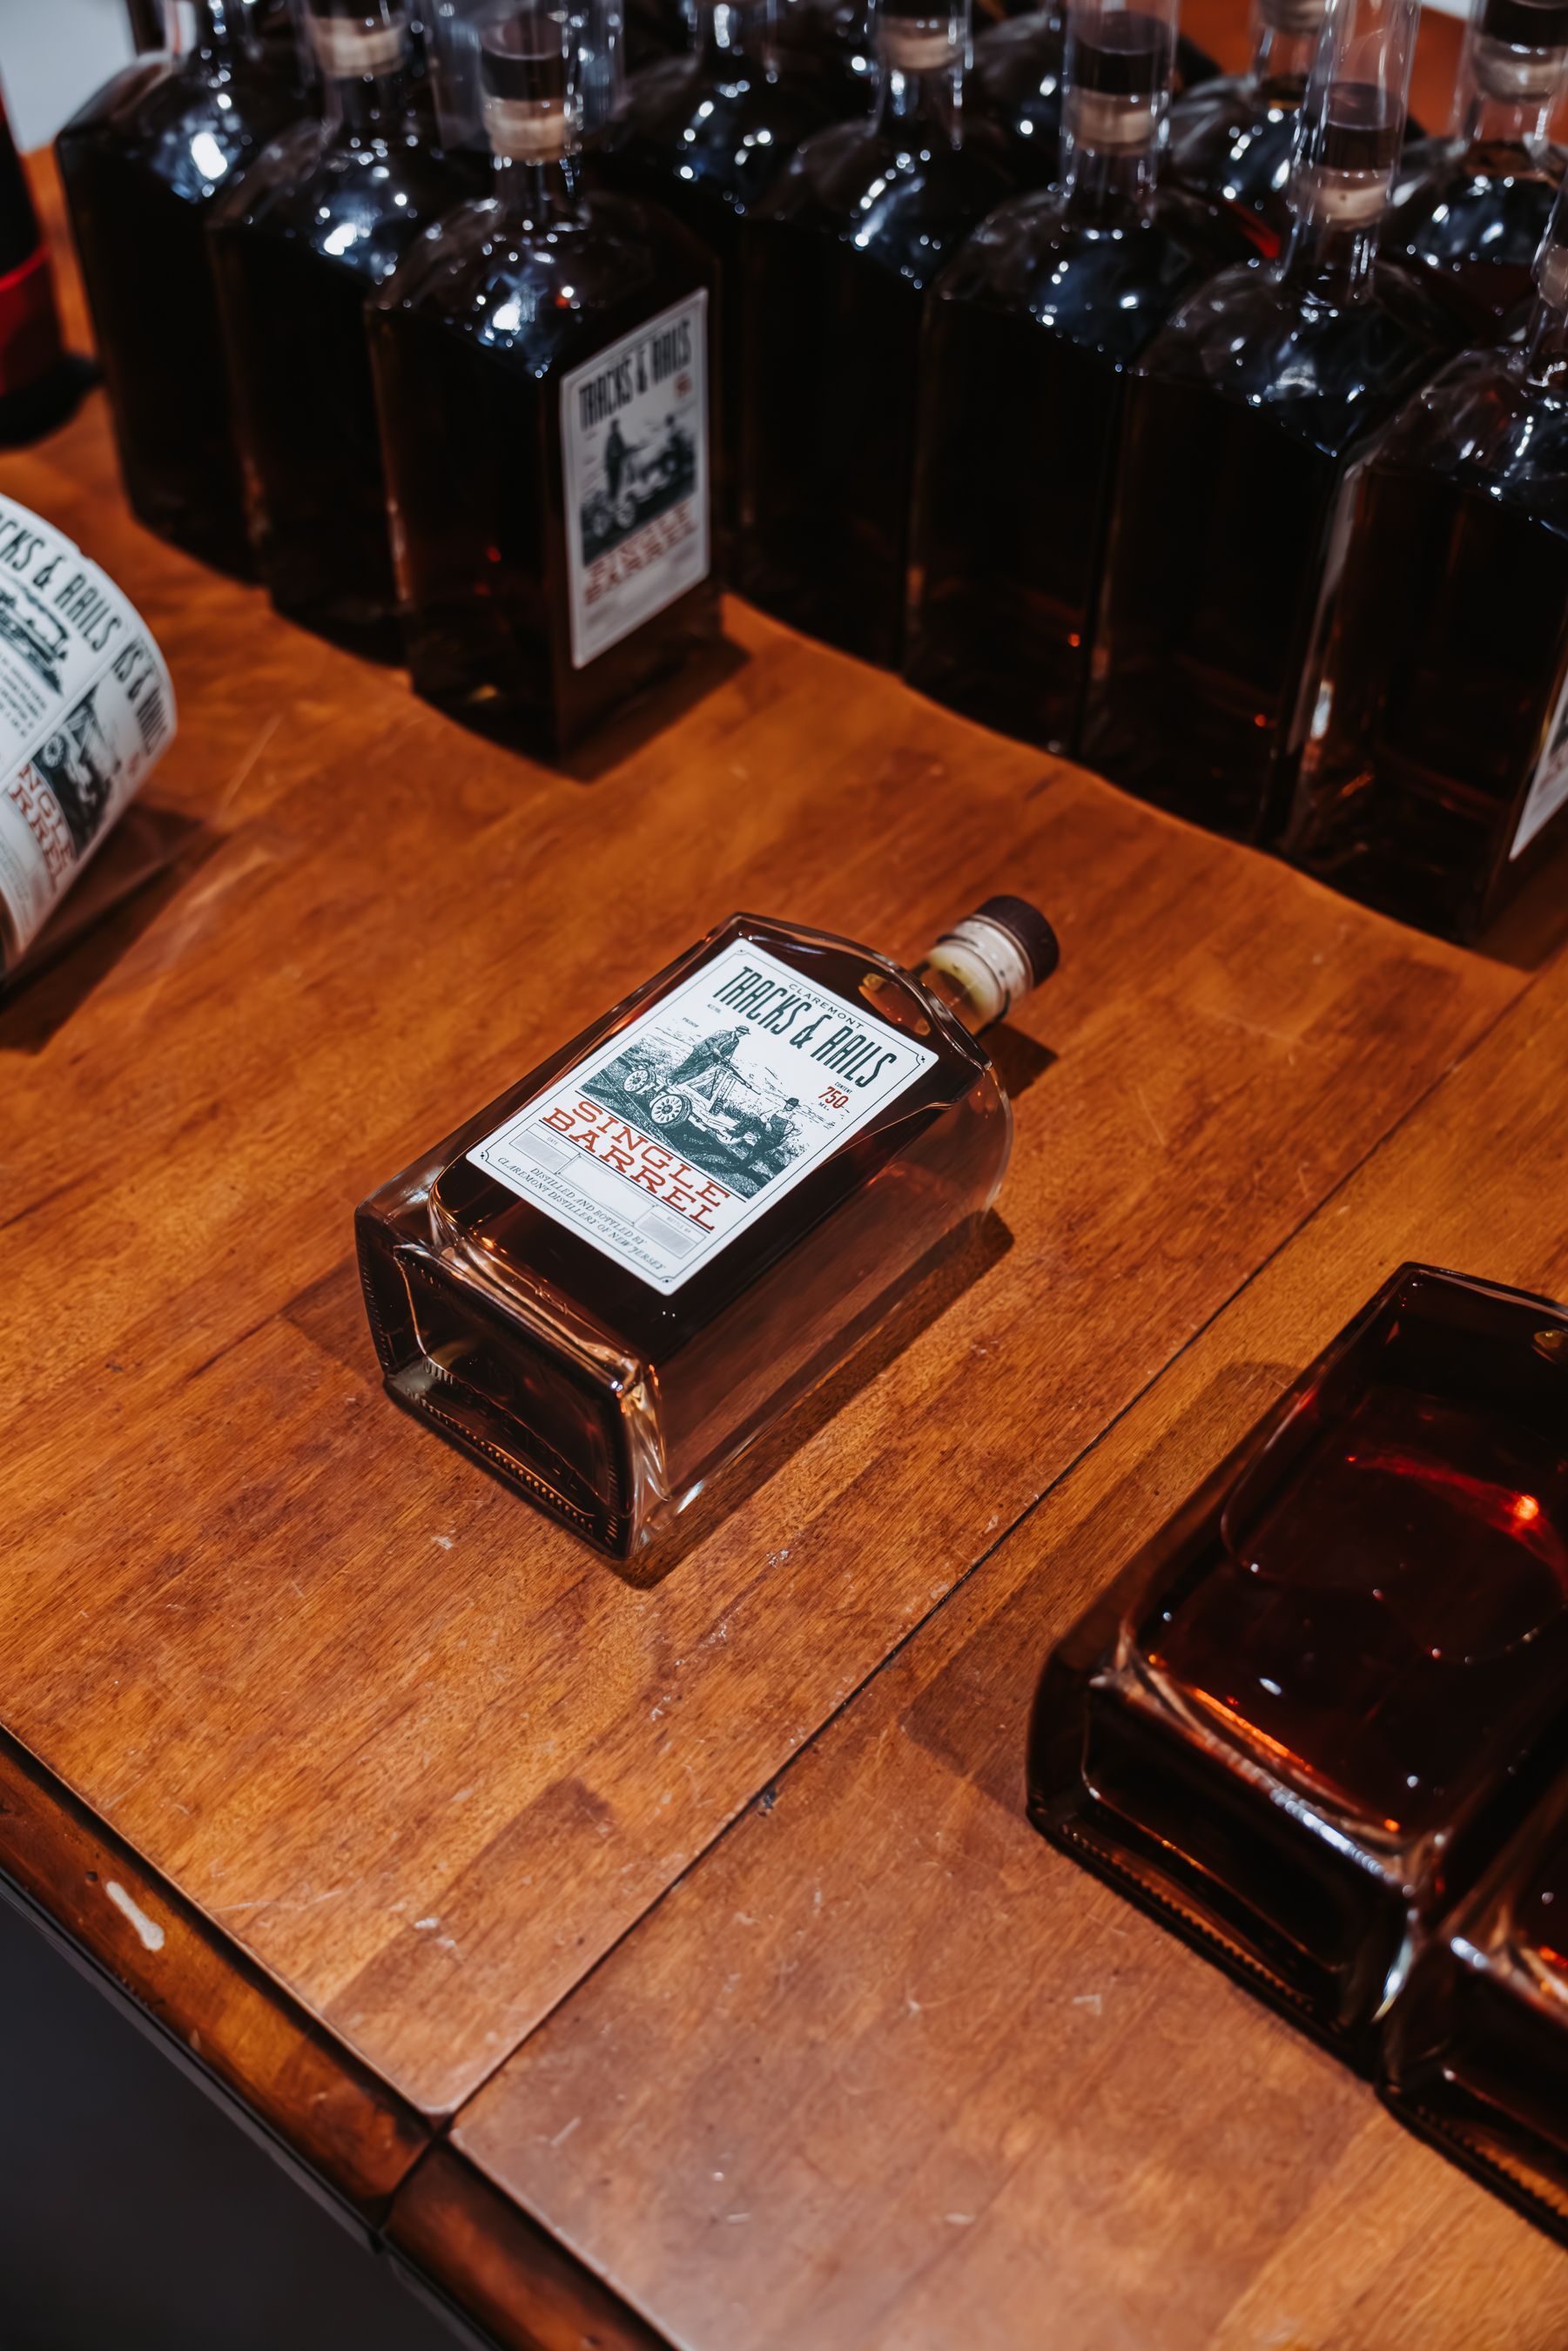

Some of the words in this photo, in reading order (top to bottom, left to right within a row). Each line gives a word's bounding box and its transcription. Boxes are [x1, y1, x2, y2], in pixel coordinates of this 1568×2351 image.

[578, 354, 635, 432] TRACKS
[652, 319, 692, 385] RAILS
[33, 553, 65, 590] &
[54, 574, 122, 651] RAILS
[712, 966, 812, 1035] TRACKS
[788, 983, 865, 1029] CLAREMONT
[789, 1014, 833, 1049] &
[810, 1026, 898, 1088] RAILS
[818, 1086, 849, 1109] 750
[542, 1107, 715, 1231] BARREL
[572, 1101, 730, 1208] SINGLE
[497, 1157, 551, 1197] CLAREMONT
[548, 1192, 601, 1227] DISTILLERY
[597, 1223, 613, 1234] OF
[609, 1230, 634, 1248] NEW
[628, 1244, 667, 1270] JERSEY
[529, 1168, 575, 1199] DISTILLED
[572, 1197, 596, 1212] AND
[593, 1209, 634, 1238] BOTTLED
[631, 1234, 648, 1246] BY
